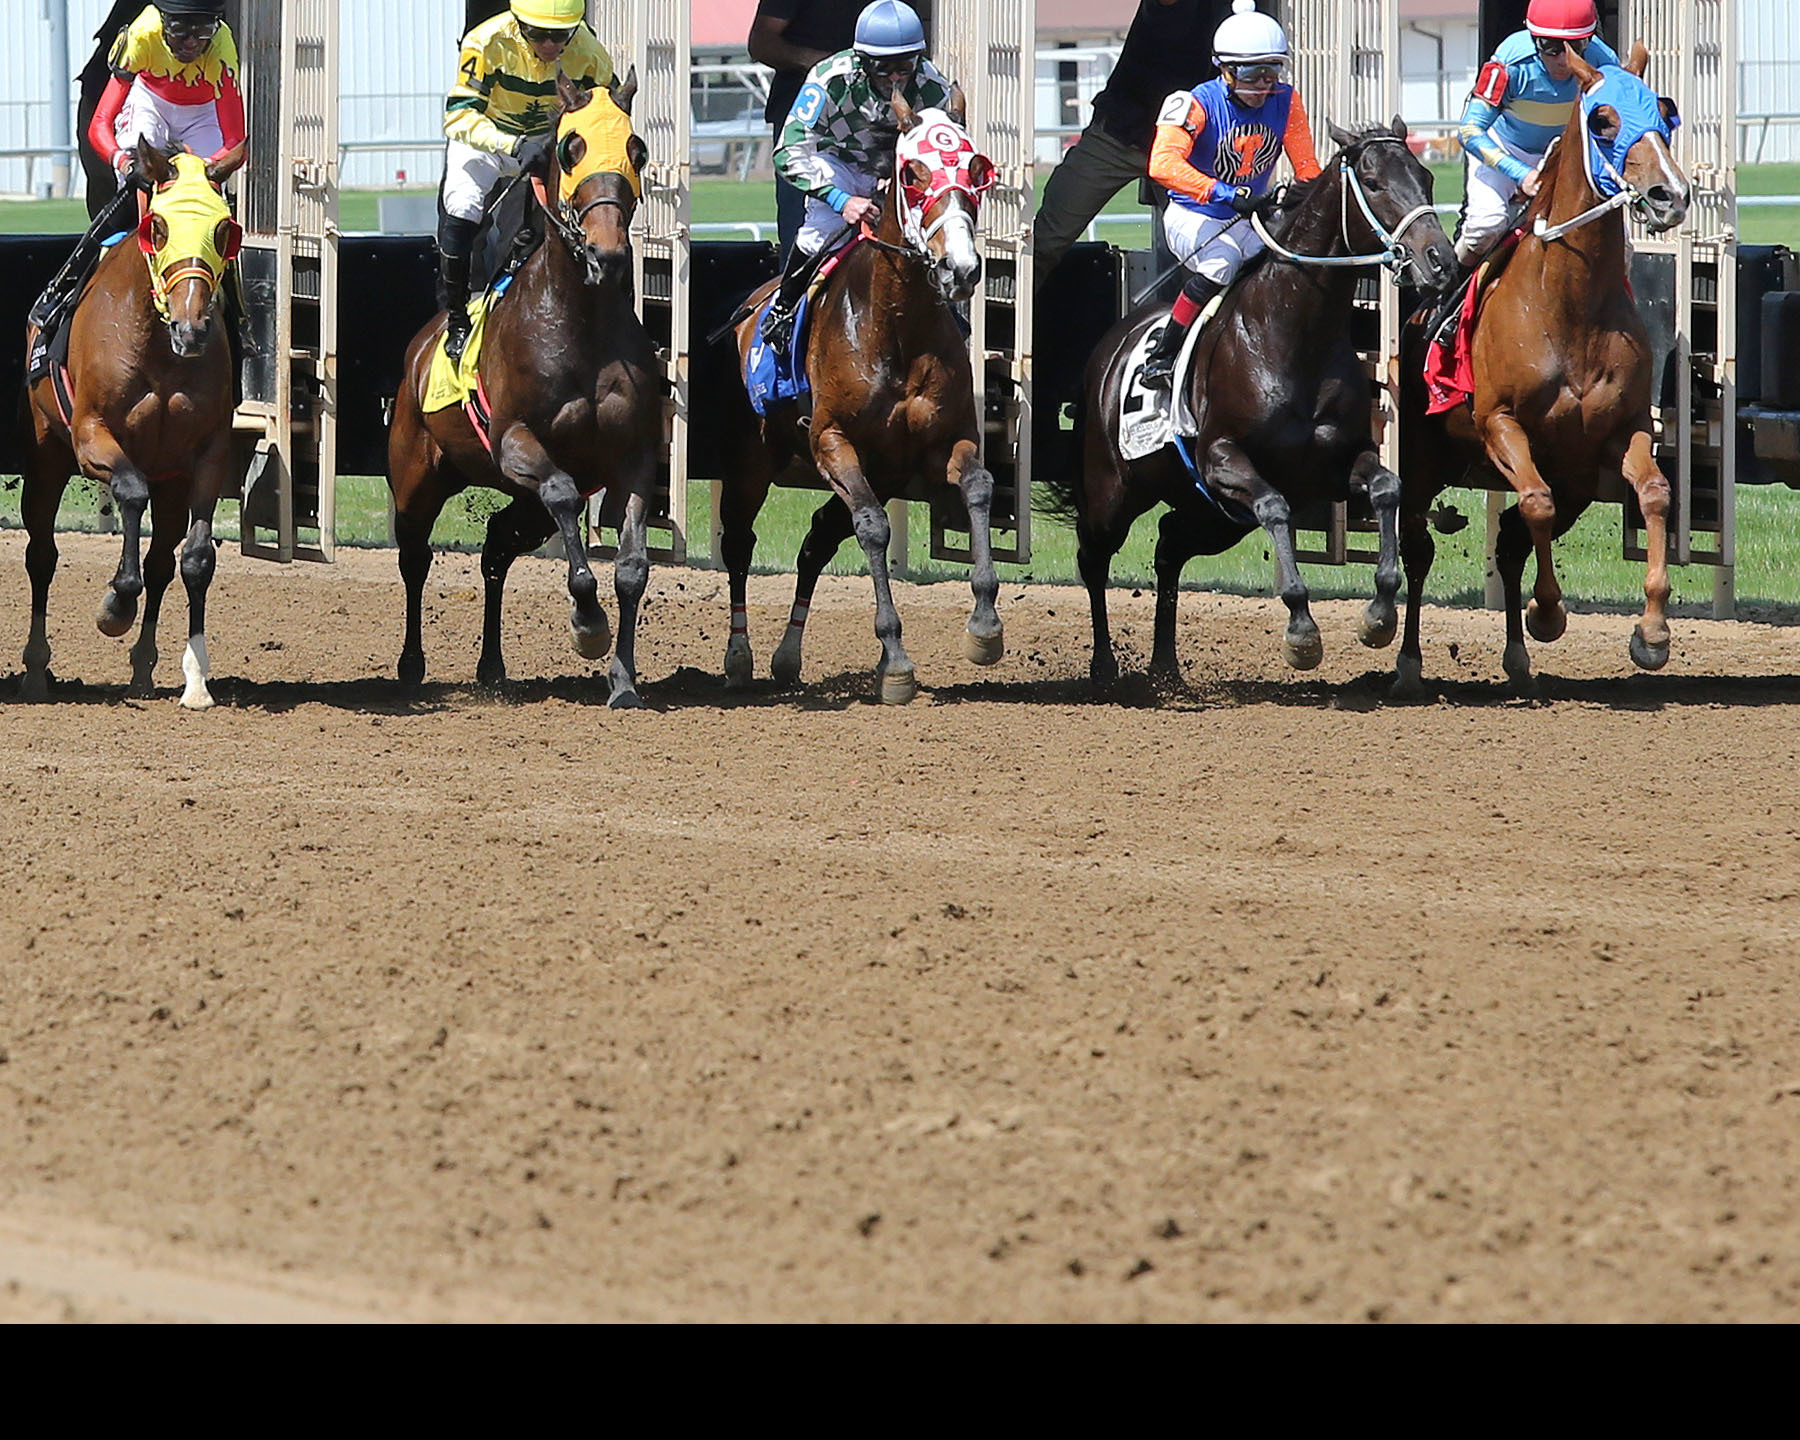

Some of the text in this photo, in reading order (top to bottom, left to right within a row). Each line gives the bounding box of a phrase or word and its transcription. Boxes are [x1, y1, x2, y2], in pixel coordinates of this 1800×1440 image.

[461, 56, 477, 83] 4
[1483, 67, 1500, 100] 1
[797, 88, 821, 122] 3
[1162, 96, 1185, 122] 2
[936, 131, 954, 147] G
[1234, 133, 1264, 177] T
